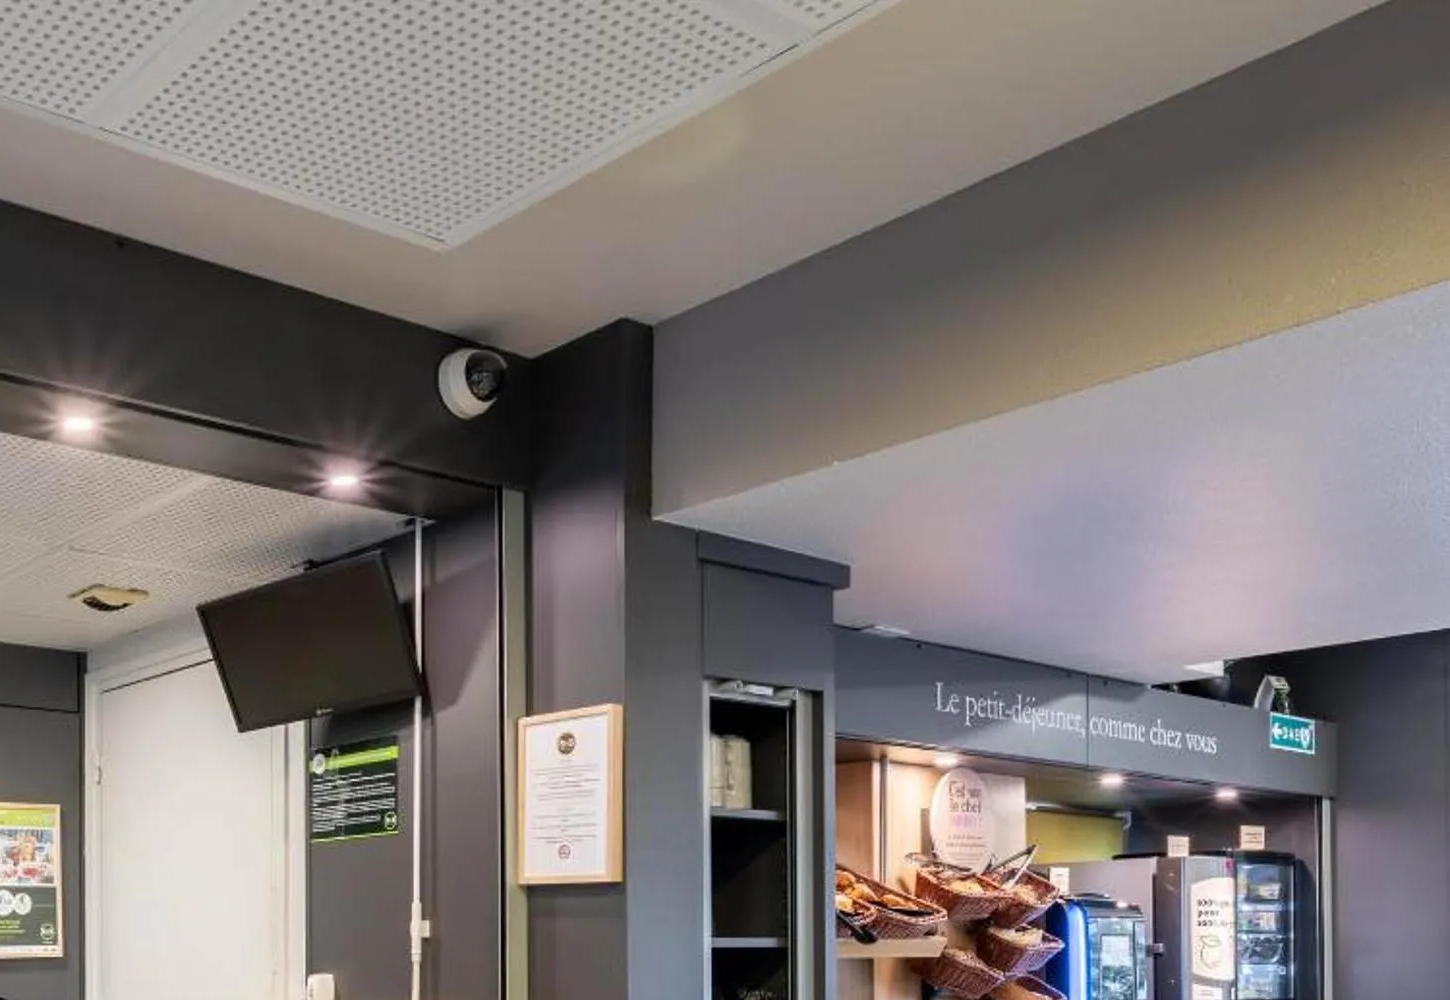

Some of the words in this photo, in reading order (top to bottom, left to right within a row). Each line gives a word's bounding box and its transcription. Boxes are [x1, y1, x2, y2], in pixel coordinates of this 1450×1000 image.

[935, 681, 961, 714] Le
[965, 690, 1086, 738] petit-déjeuner,
[1089, 715, 1146, 743] comme
[1149, 718, 1183, 749] chez
[1185, 732, 1219, 754] vous
